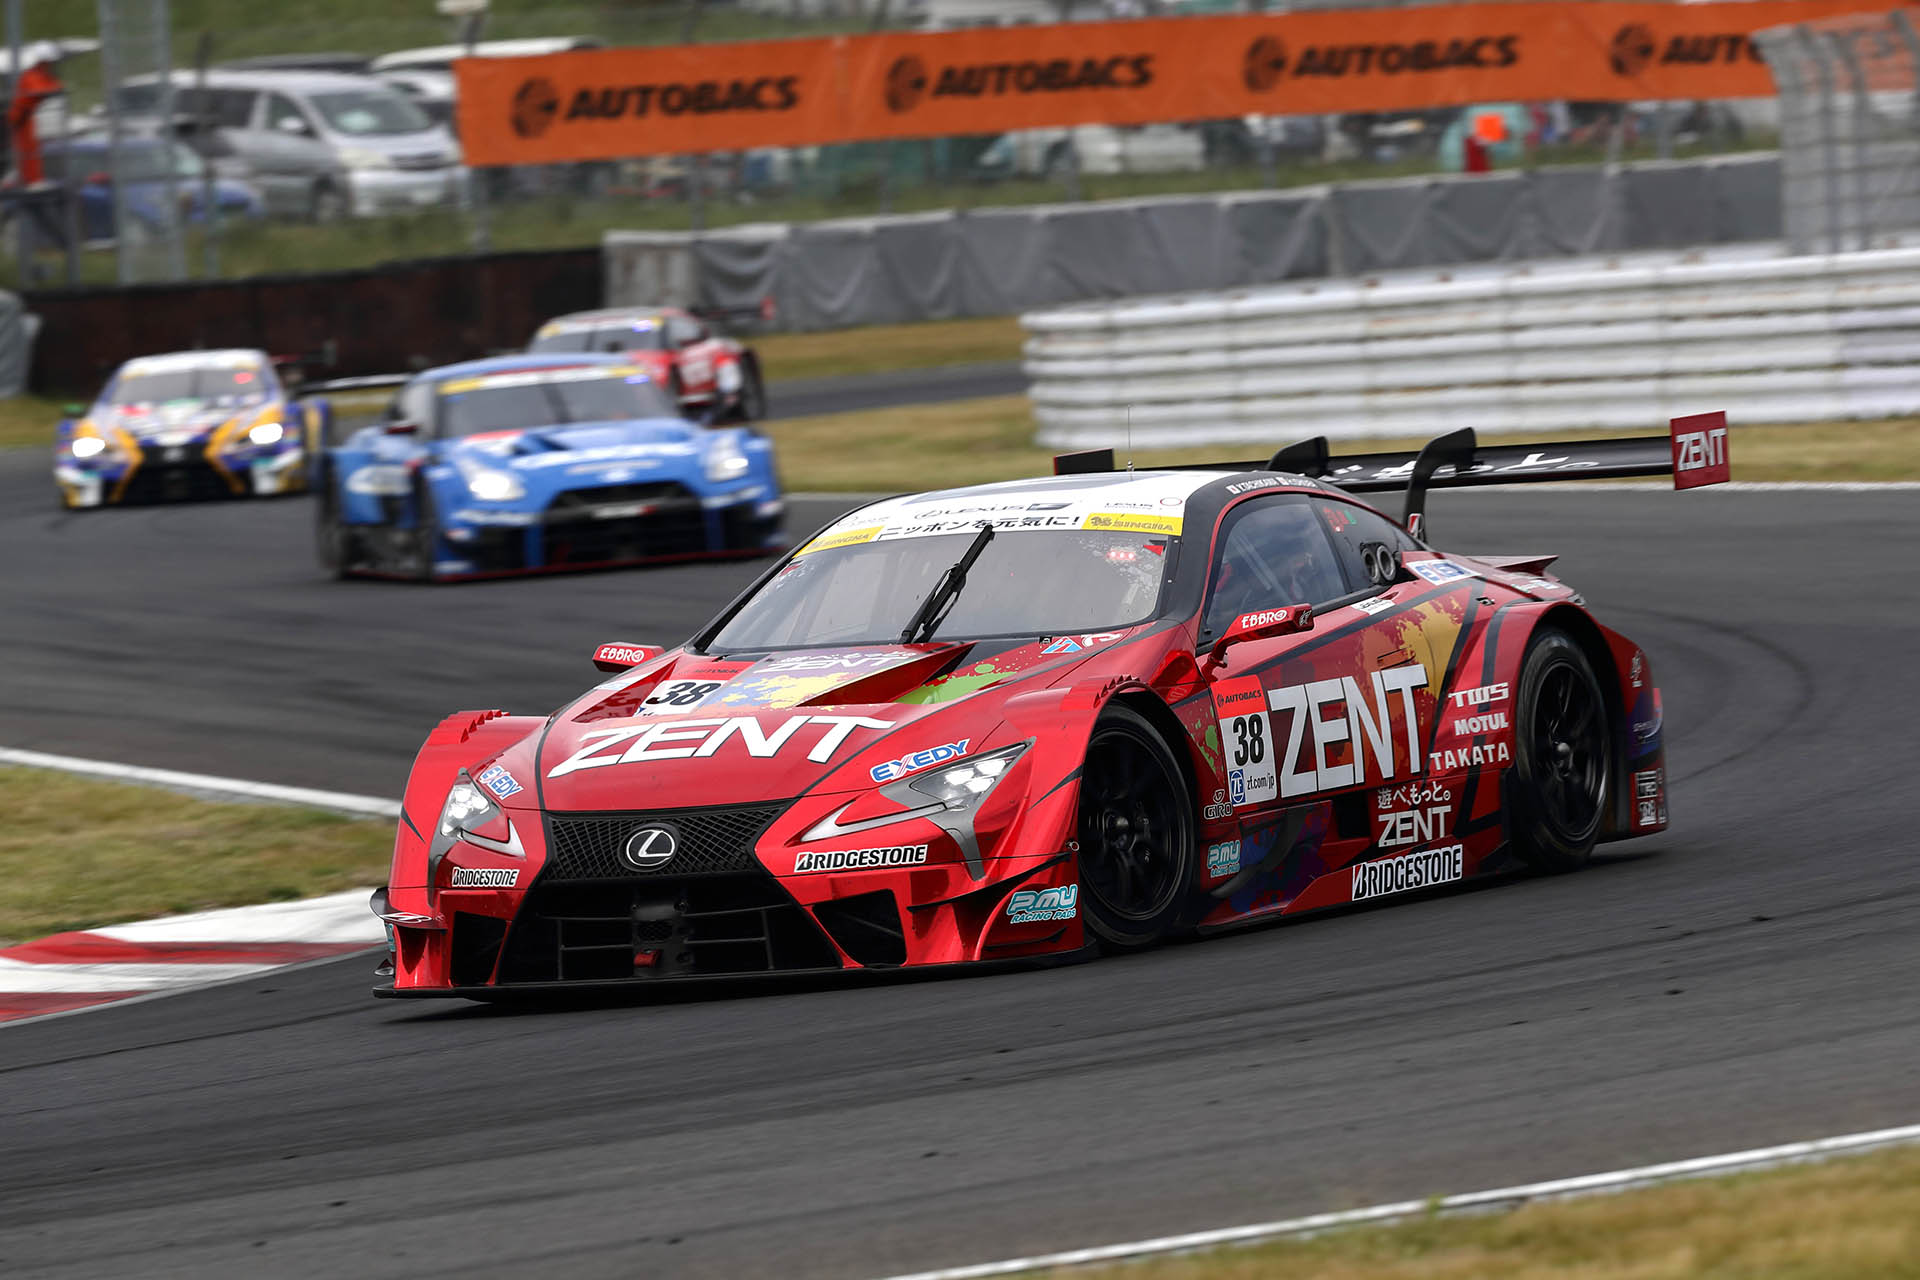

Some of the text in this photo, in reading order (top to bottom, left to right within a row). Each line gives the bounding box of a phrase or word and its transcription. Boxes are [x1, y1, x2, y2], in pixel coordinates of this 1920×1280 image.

[1292, 35, 1519, 77] AUTOBACS
[931, 53, 1154, 96] AUTOBACS
[564, 75, 799, 121] AUTOBACS
[1676, 428, 1727, 471] ZENT
[1241, 610, 1287, 629] EBBRO
[599, 647, 645, 663] EBBRO
[753, 656, 908, 674] ZENT
[646, 682, 721, 706] 38
[1225, 690, 1262, 704] AUTOBACS
[1267, 664, 1429, 798] ZENT
[1454, 712, 1509, 736] MOTUL
[547, 715, 896, 778] ZENT
[1233, 714, 1264, 766] 38
[871, 739, 968, 781] EXEDY
[1430, 742, 1509, 771] TAKATA
[481, 766, 522, 800] EXEDY
[1247, 773, 1275, 790] zf.com/jp
[1205, 802, 1232, 819] GIRO
[1378, 805, 1451, 848] ZENT
[796, 846, 926, 871] BRIDGESTONE
[1354, 847, 1462, 899] BRIDGESTONE
[453, 868, 517, 886] BRIDGESTONE
[1011, 909, 1076, 923] RACING PADS
